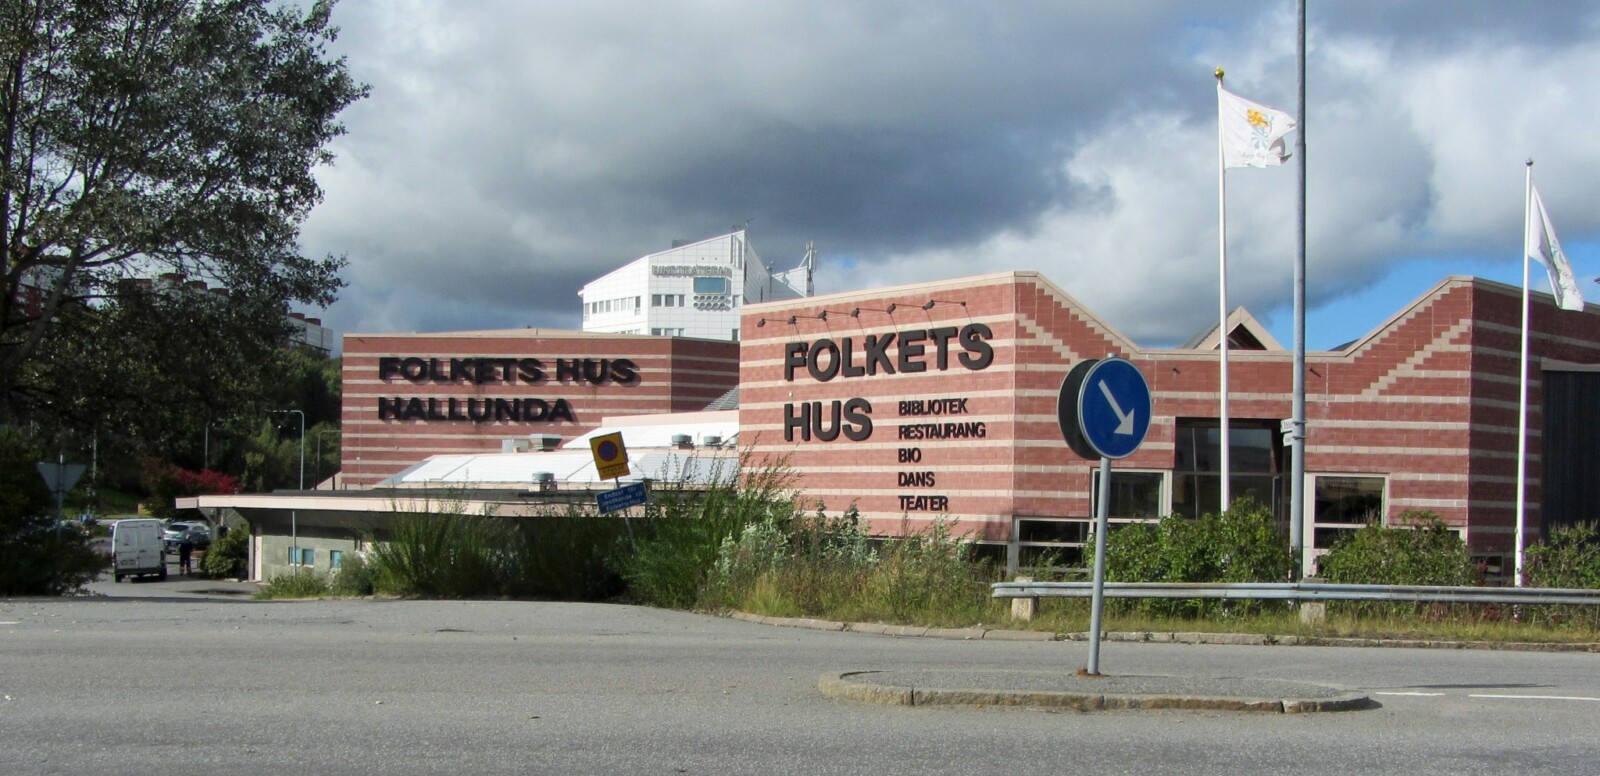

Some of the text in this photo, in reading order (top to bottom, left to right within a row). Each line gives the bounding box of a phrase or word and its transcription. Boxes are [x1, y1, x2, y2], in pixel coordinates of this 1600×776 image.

[784, 323, 994, 382] FOLKETS
[378, 357, 638, 386] FOLKETS HUS
[378, 397, 574, 422] HALLUNDA
[898, 398, 968, 416] BIBLIOTEK
[784, 397, 873, 441] HUS
[898, 422, 986, 440] RESTAURANG
[898, 448, 922, 463] BIO
[898, 471, 935, 487] DANS
[898, 495, 948, 511] TEATER
